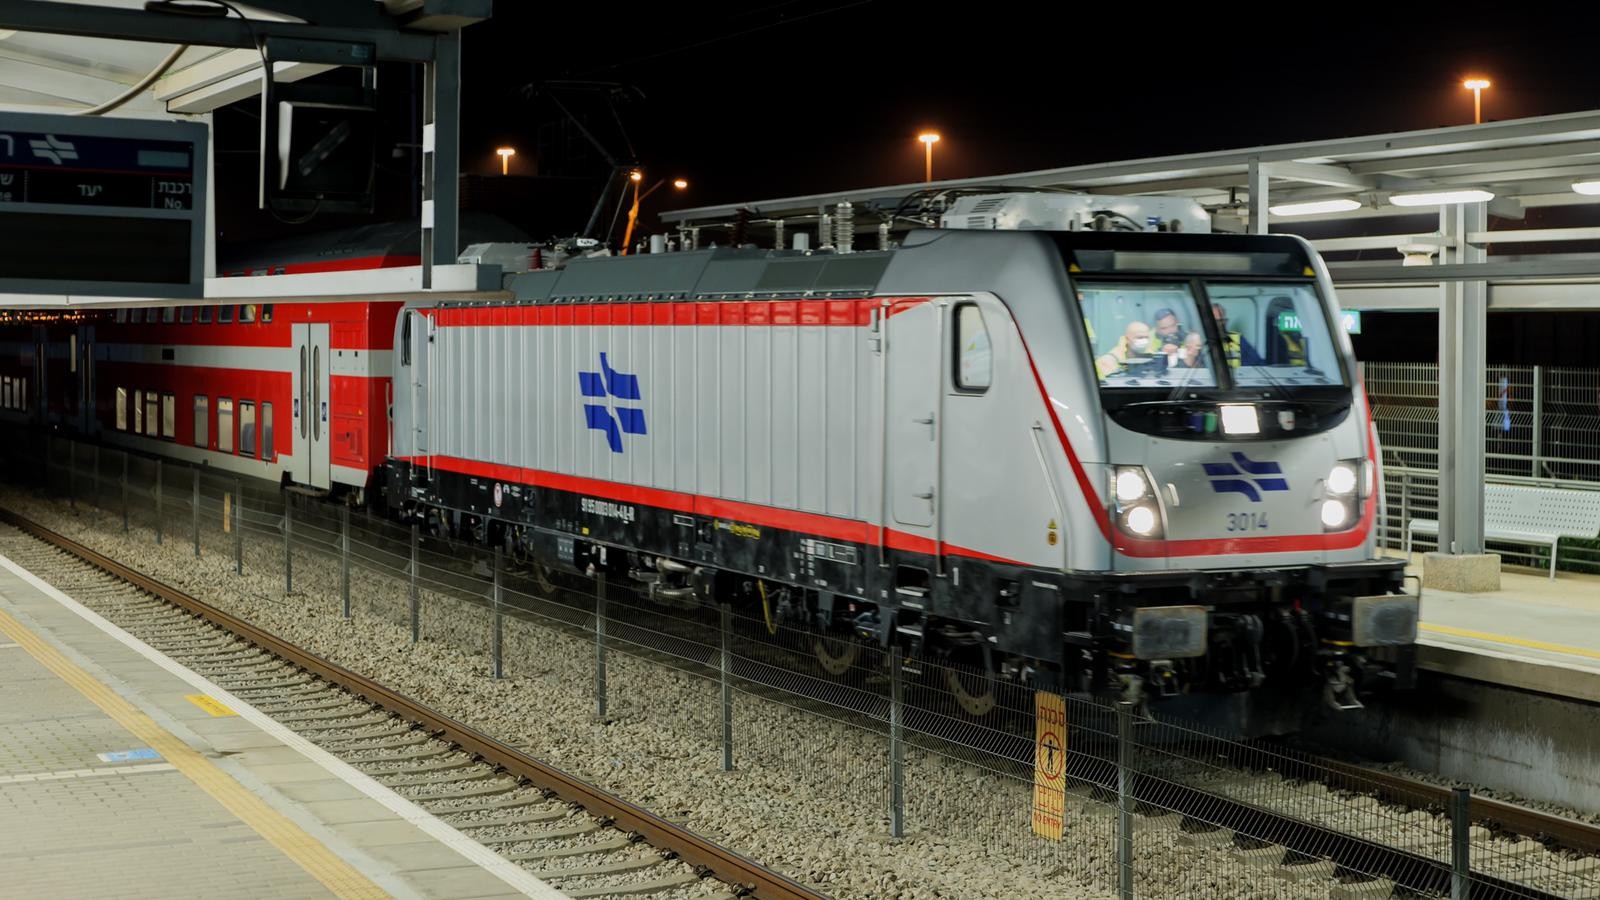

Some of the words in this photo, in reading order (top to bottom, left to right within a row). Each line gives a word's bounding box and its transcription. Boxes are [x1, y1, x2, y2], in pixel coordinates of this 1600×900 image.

[77, 184, 103, 197] יעד
[158, 181, 192, 194] רכבת
[1226, 512, 1269, 531] 3014
